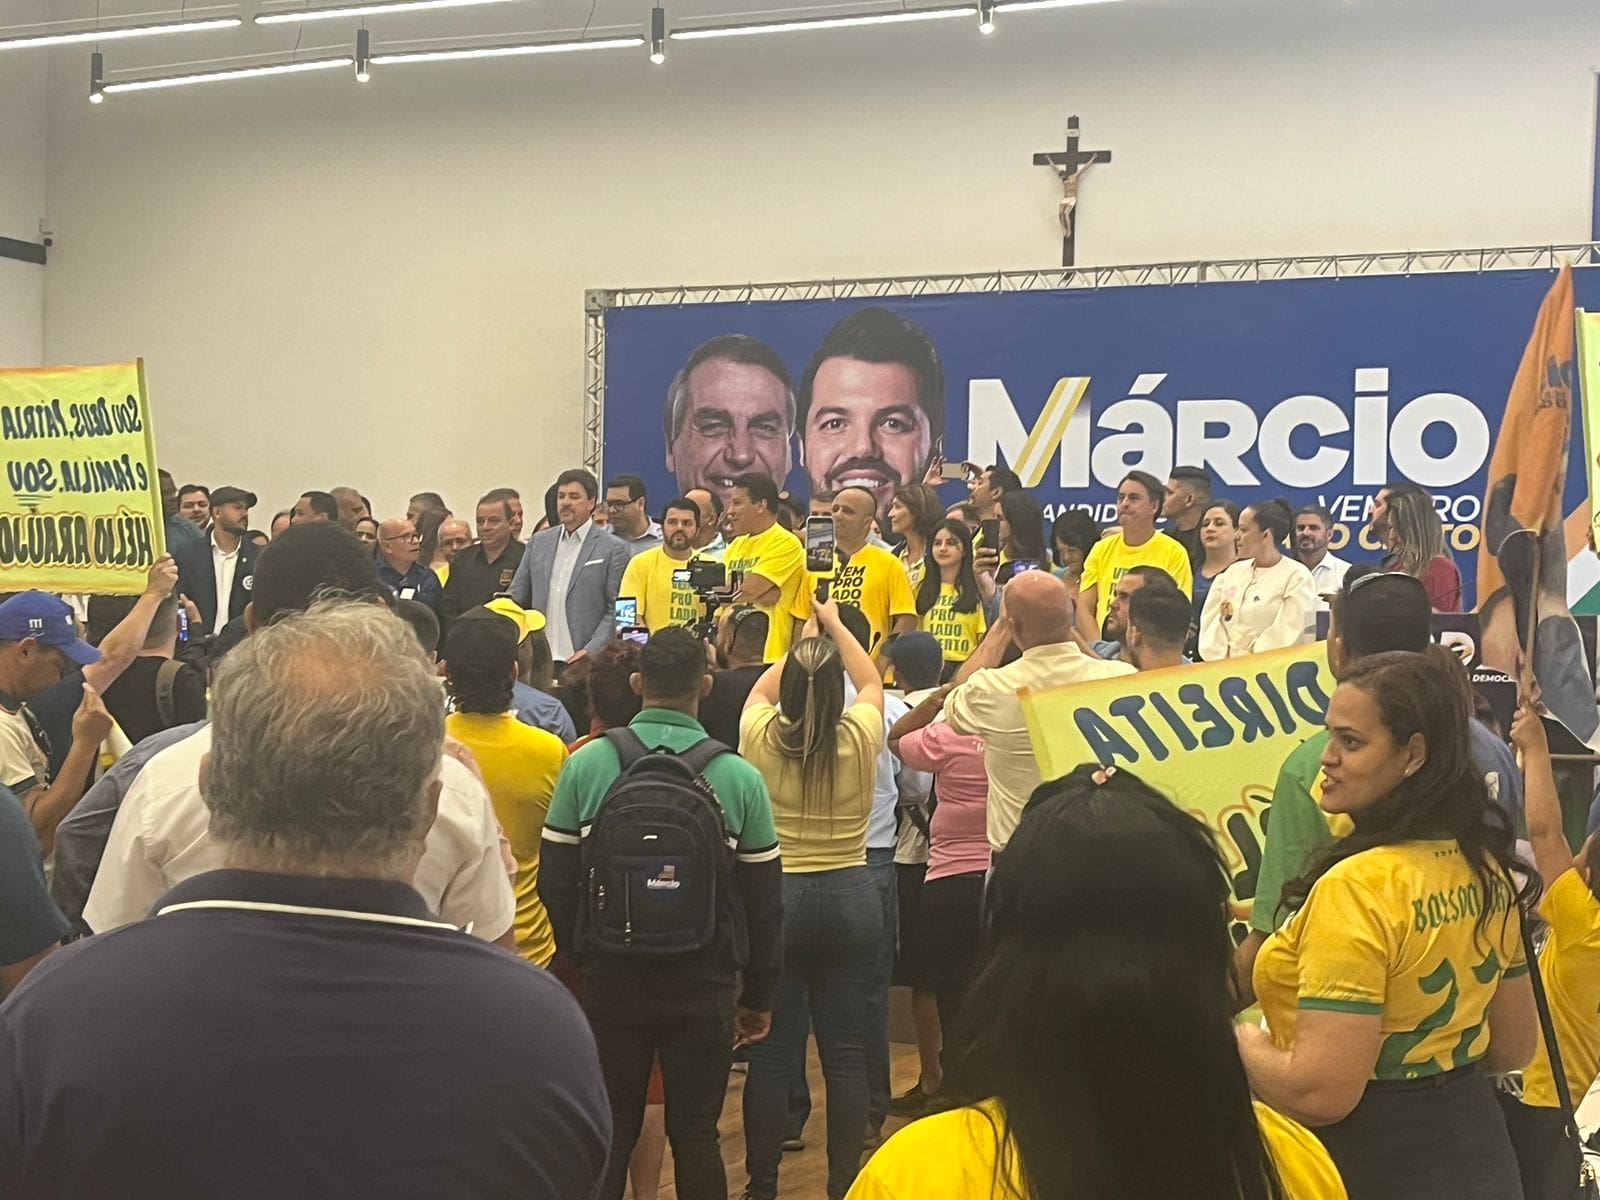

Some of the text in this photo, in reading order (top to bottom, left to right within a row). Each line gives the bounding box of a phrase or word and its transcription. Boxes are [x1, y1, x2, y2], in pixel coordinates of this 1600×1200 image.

[1431, 495, 1480, 521] RO
[833, 577, 863, 589] PRO
[832, 589, 862, 600] ADO
